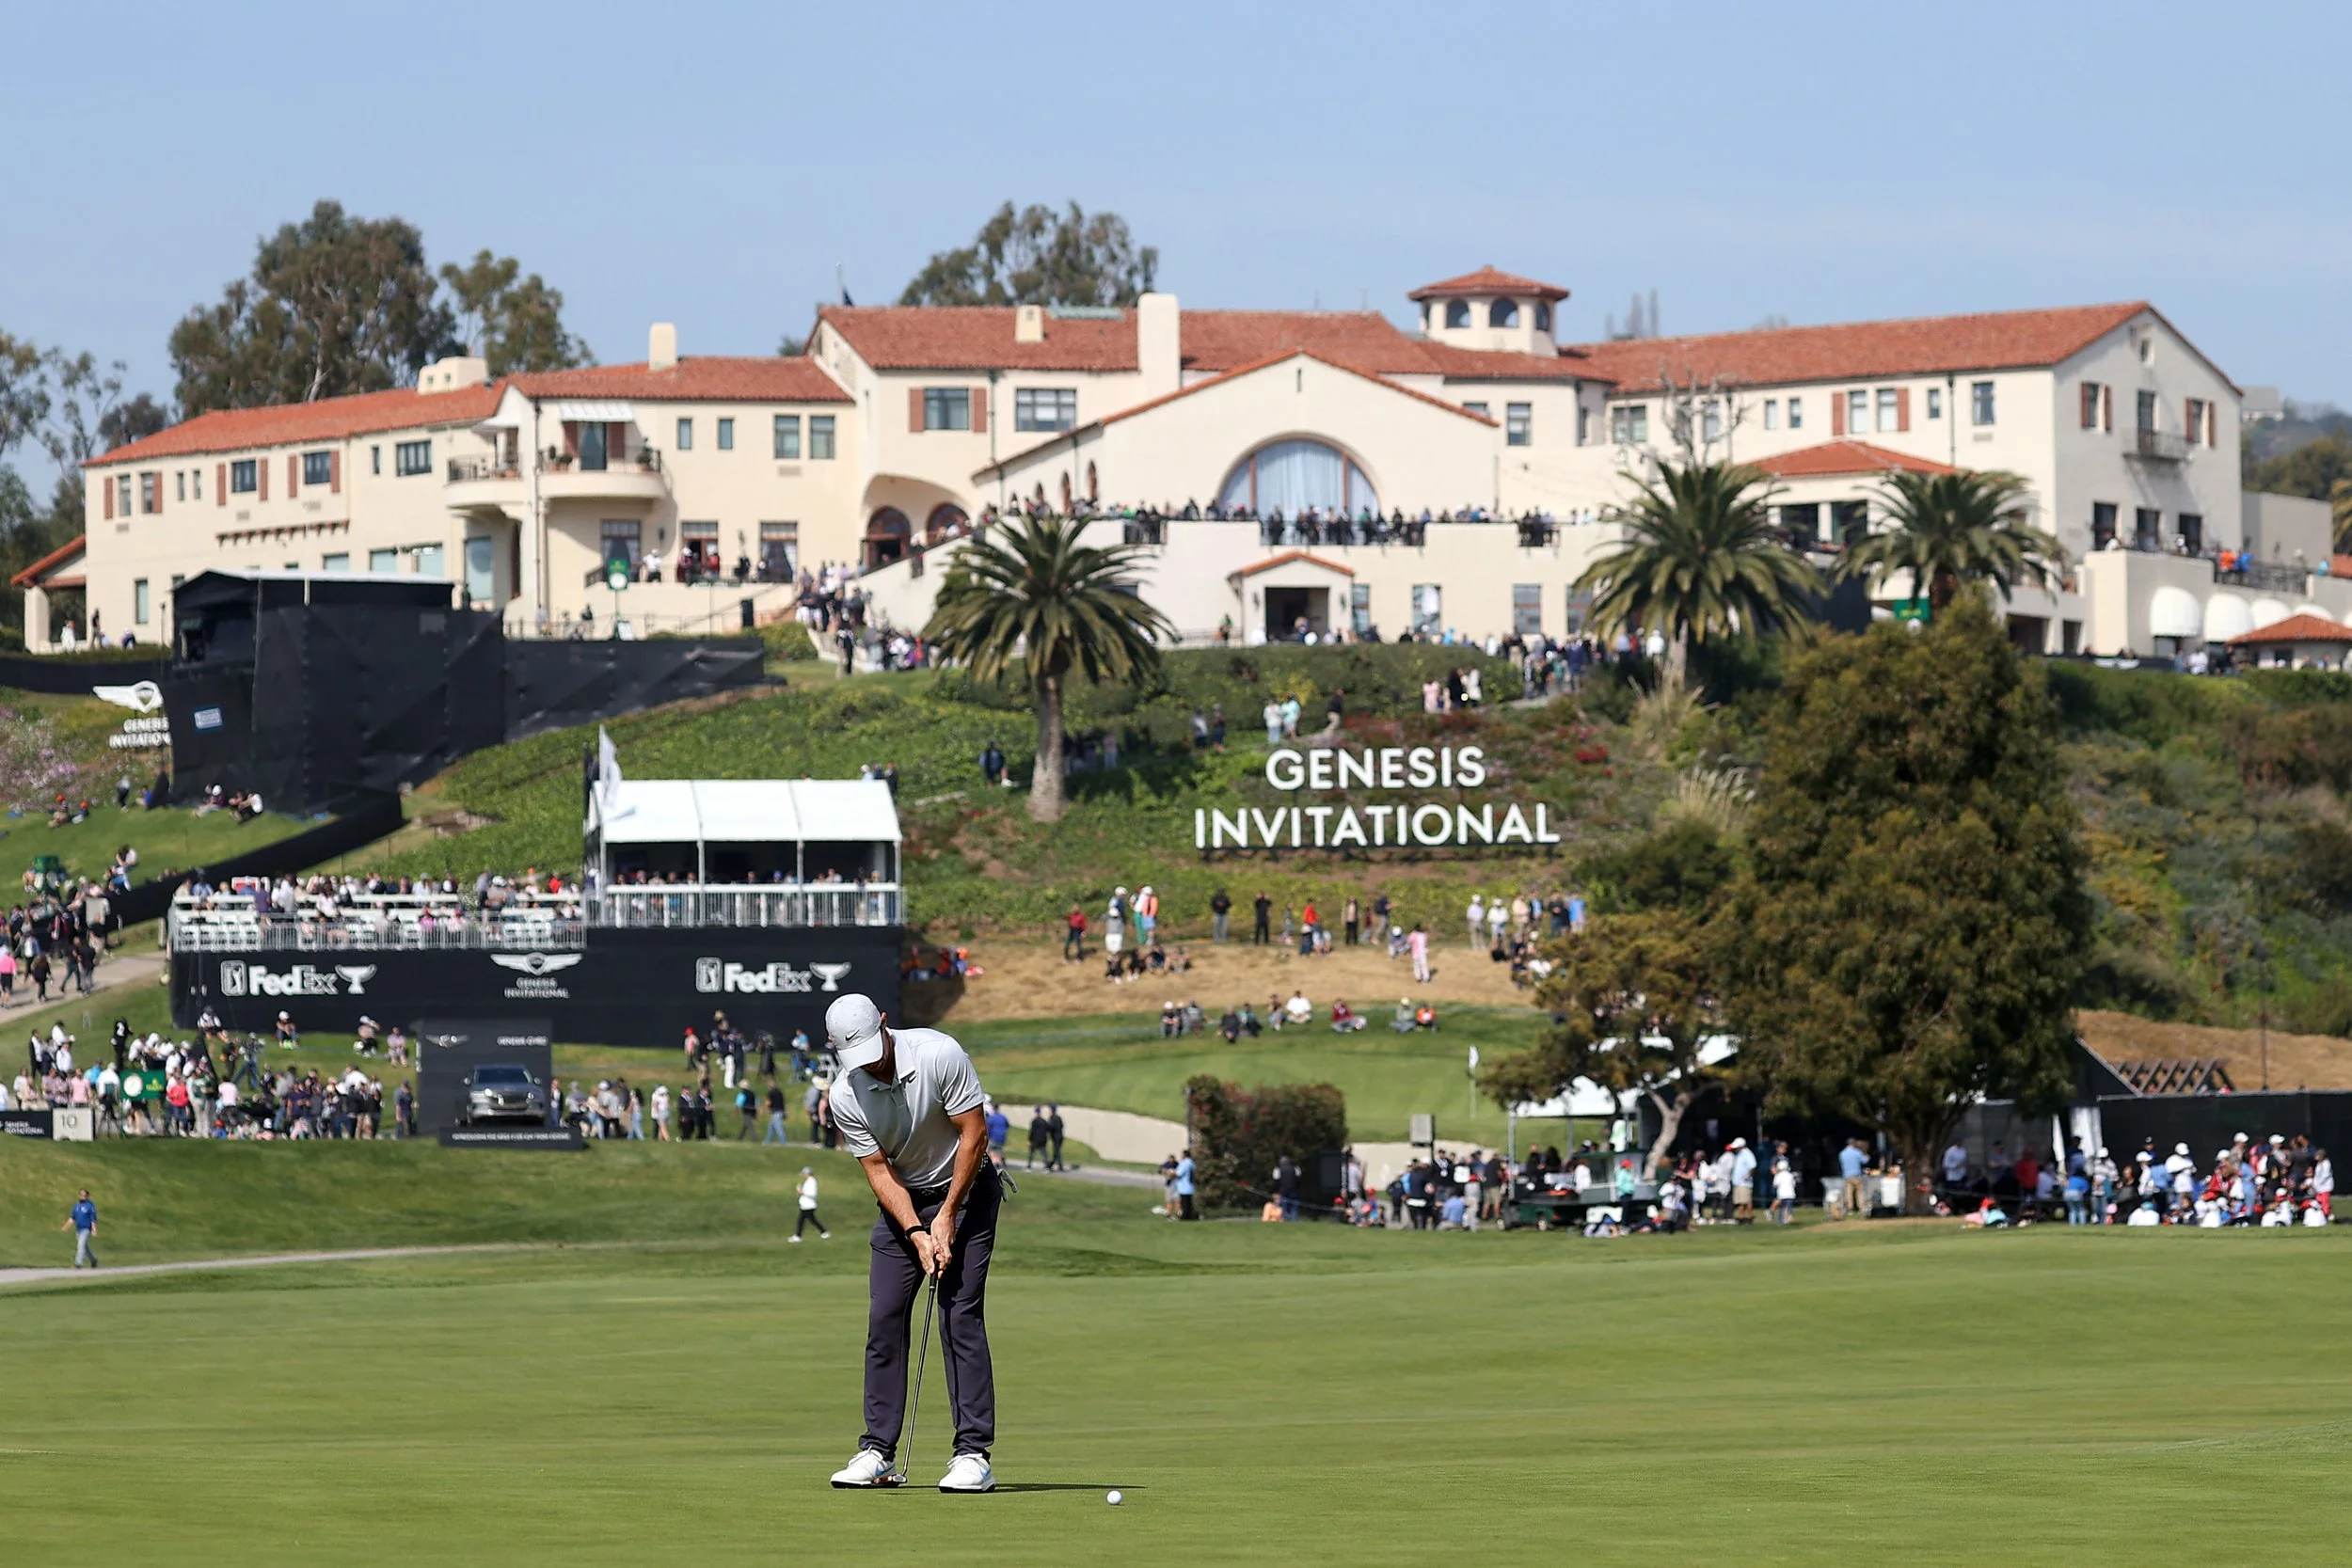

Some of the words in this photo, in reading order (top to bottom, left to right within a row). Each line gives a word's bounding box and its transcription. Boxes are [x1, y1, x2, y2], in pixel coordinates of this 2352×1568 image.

[123, 716, 169, 733] GENESIS
[1265, 746, 1486, 792] GENESIS
[1195, 802, 1562, 849] INVITATIONAL
[248, 964, 339, 996] FedEx
[516, 977, 558, 989] GENESIS
[723, 961, 813, 993] FedEx
[503, 988, 570, 998] INVITATIONAL
[61, 1114, 78, 1129] 10
